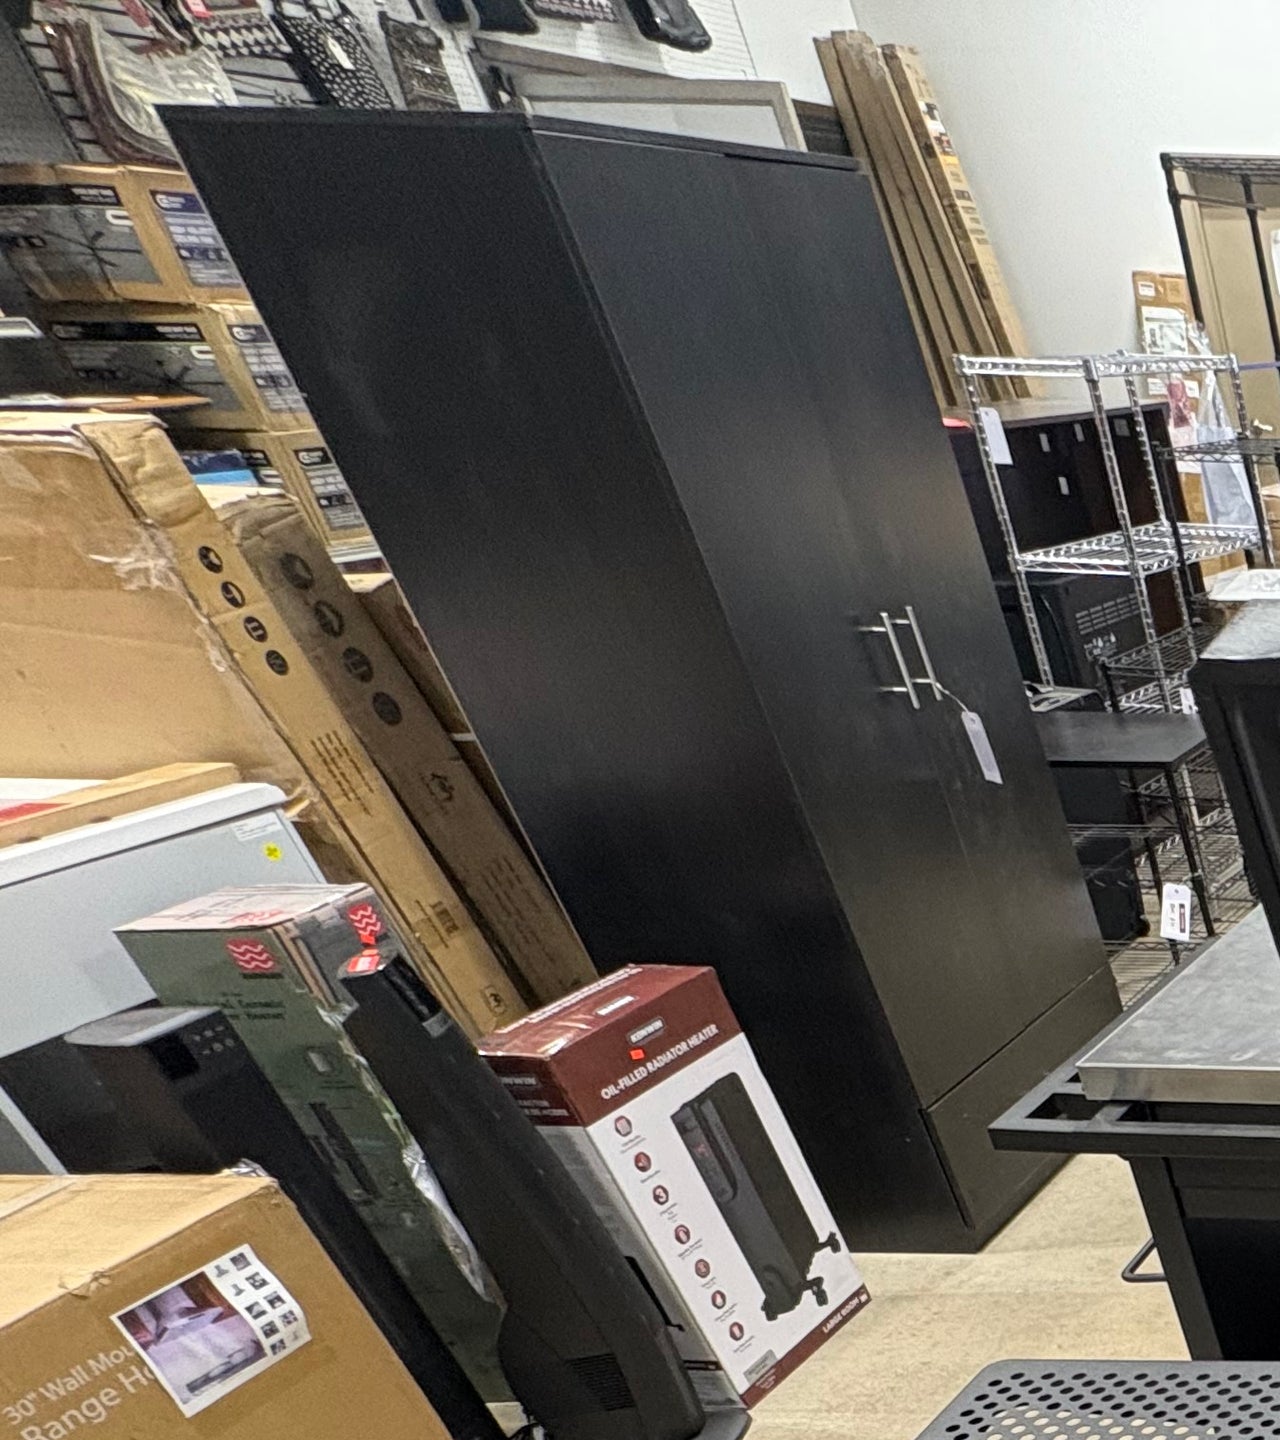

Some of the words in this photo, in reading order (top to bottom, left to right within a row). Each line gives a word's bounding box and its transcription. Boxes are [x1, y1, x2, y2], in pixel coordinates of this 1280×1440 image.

[601, 1066, 648, 1100] OIL-FILLED
[646, 1041, 690, 1073] RADIATOR
[687, 1023, 720, 1049] HEATER
[2, 1391, 38, 1426] 30"
[38, 1364, 92, 1401] Wall
[86, 1345, 135, 1377] Mou
